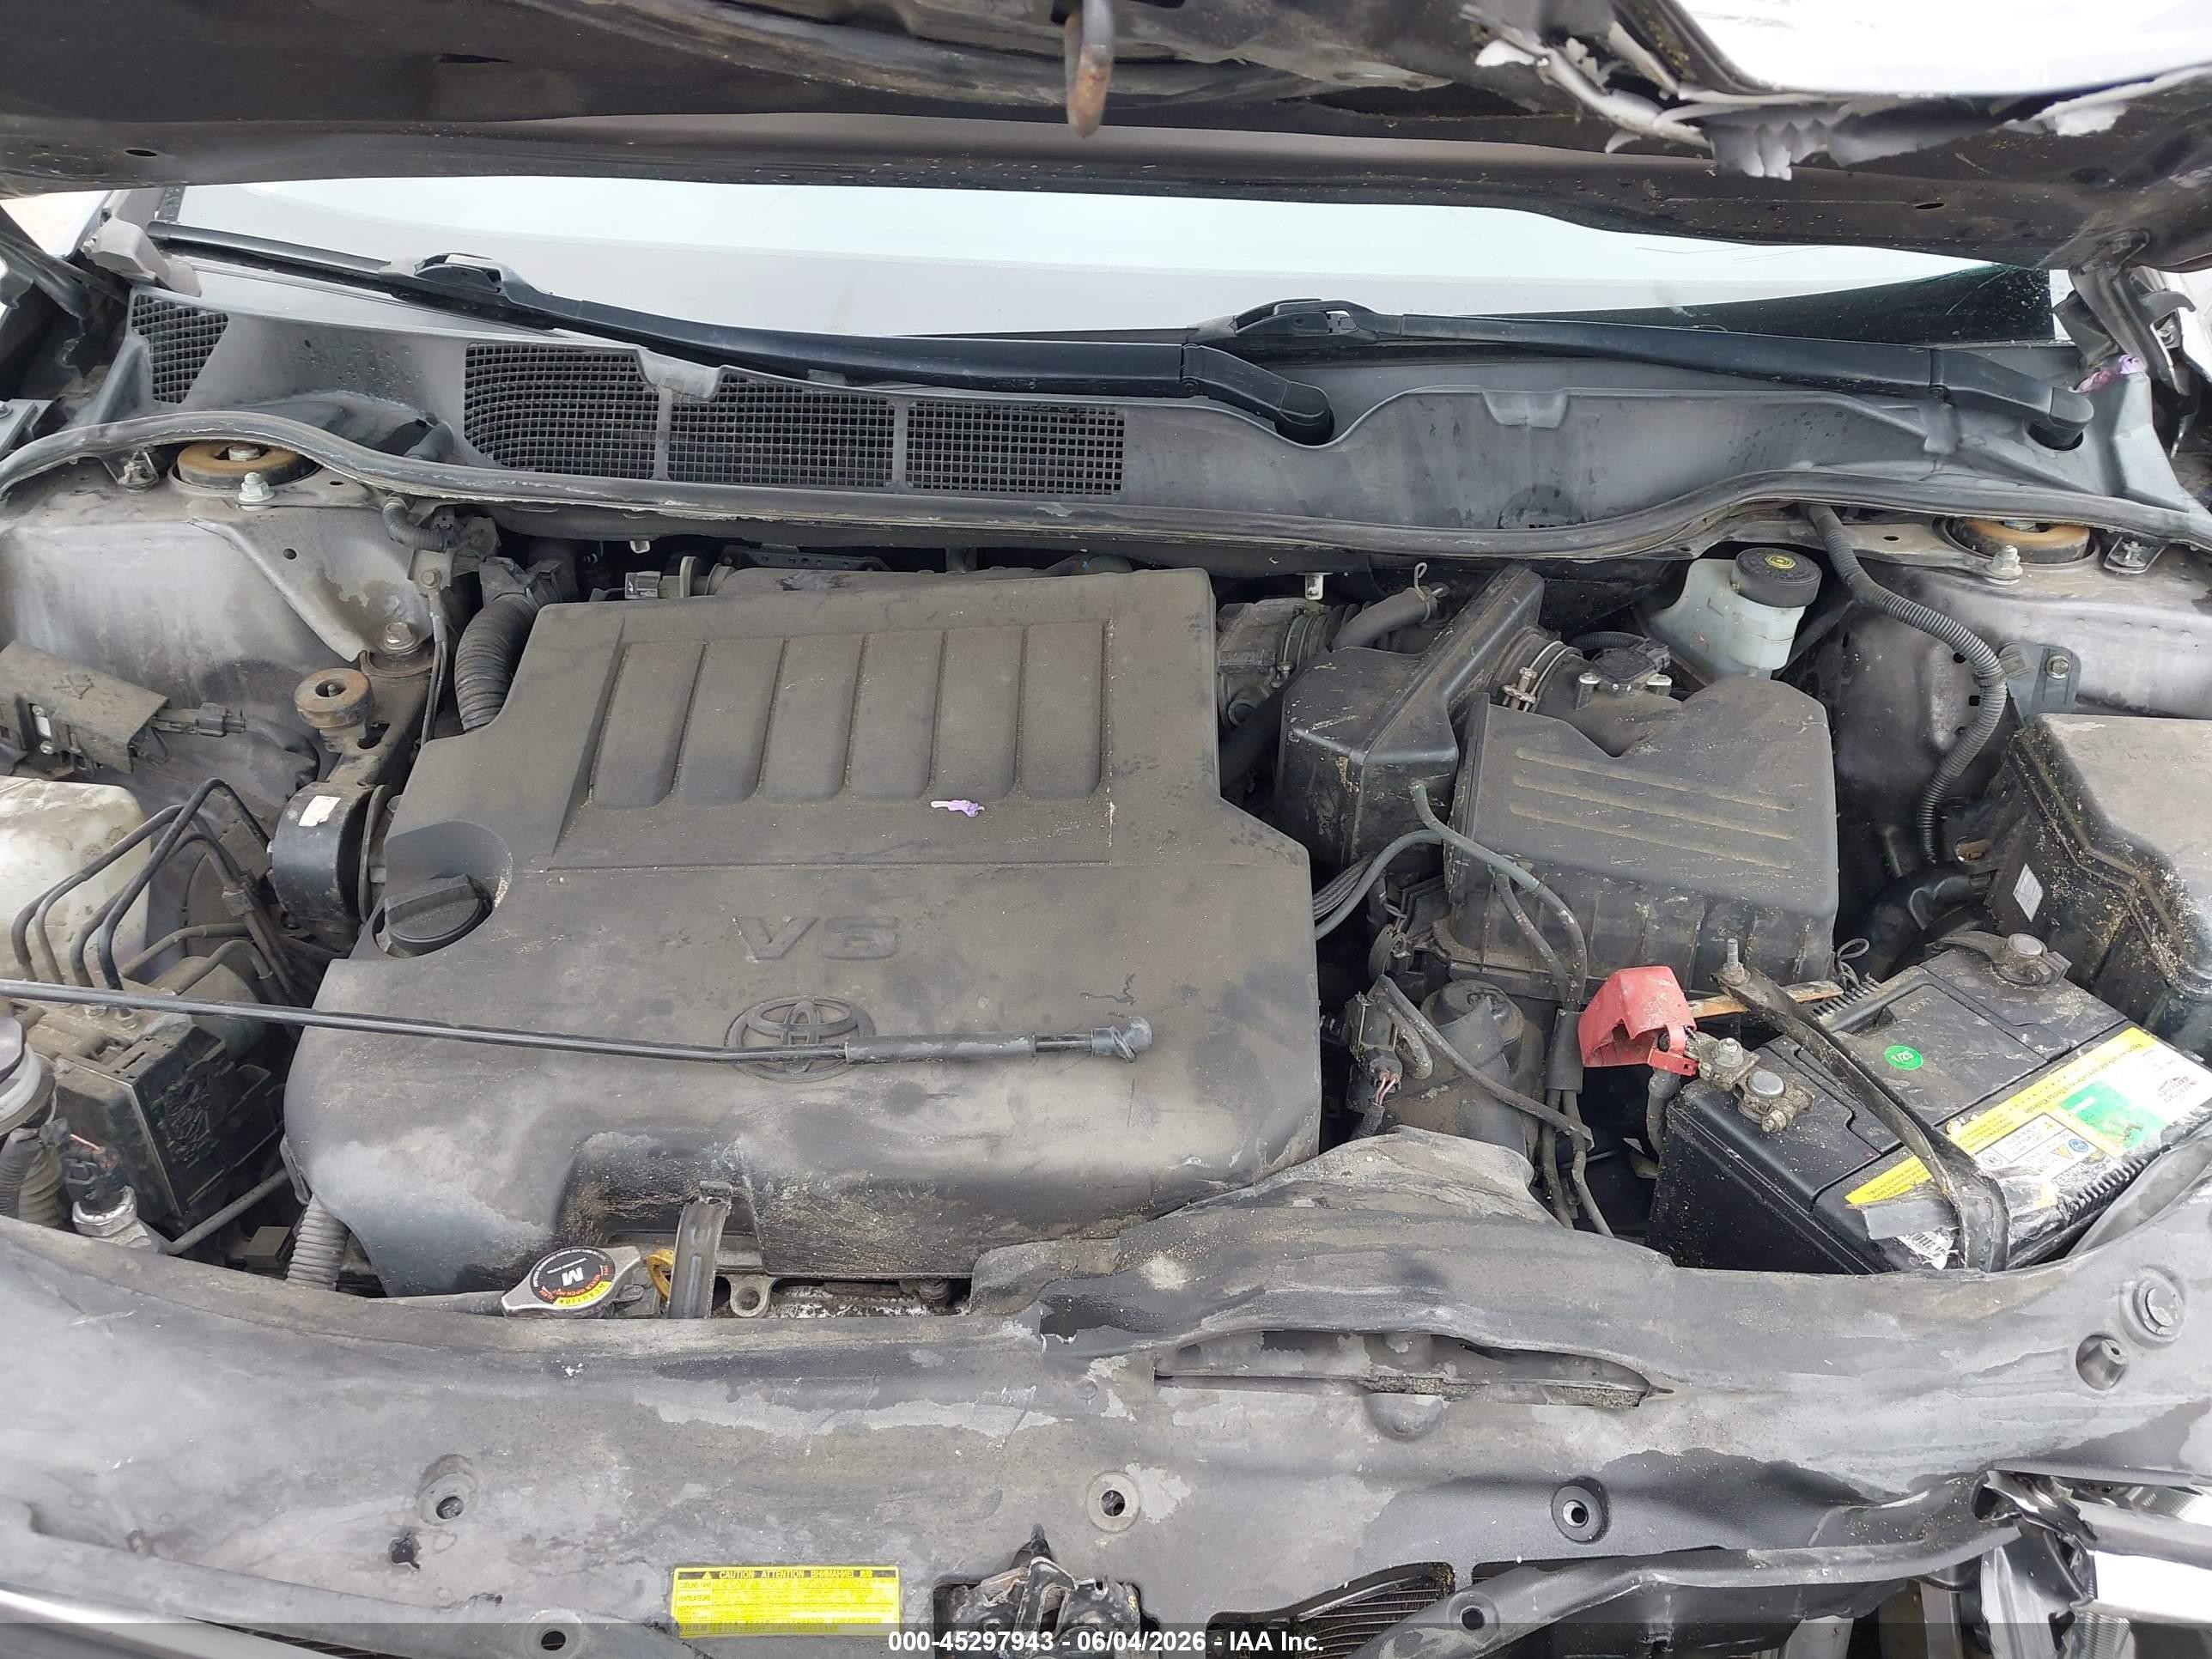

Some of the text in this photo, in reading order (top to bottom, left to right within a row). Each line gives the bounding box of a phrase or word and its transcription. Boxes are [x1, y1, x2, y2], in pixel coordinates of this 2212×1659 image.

[733, 916, 901, 961] V6
[562, 1267, 584, 1286] M
[559, 1288, 599, 1304] CAUTION
[719, 1570, 805, 1579] CAUTION ATTENTION
